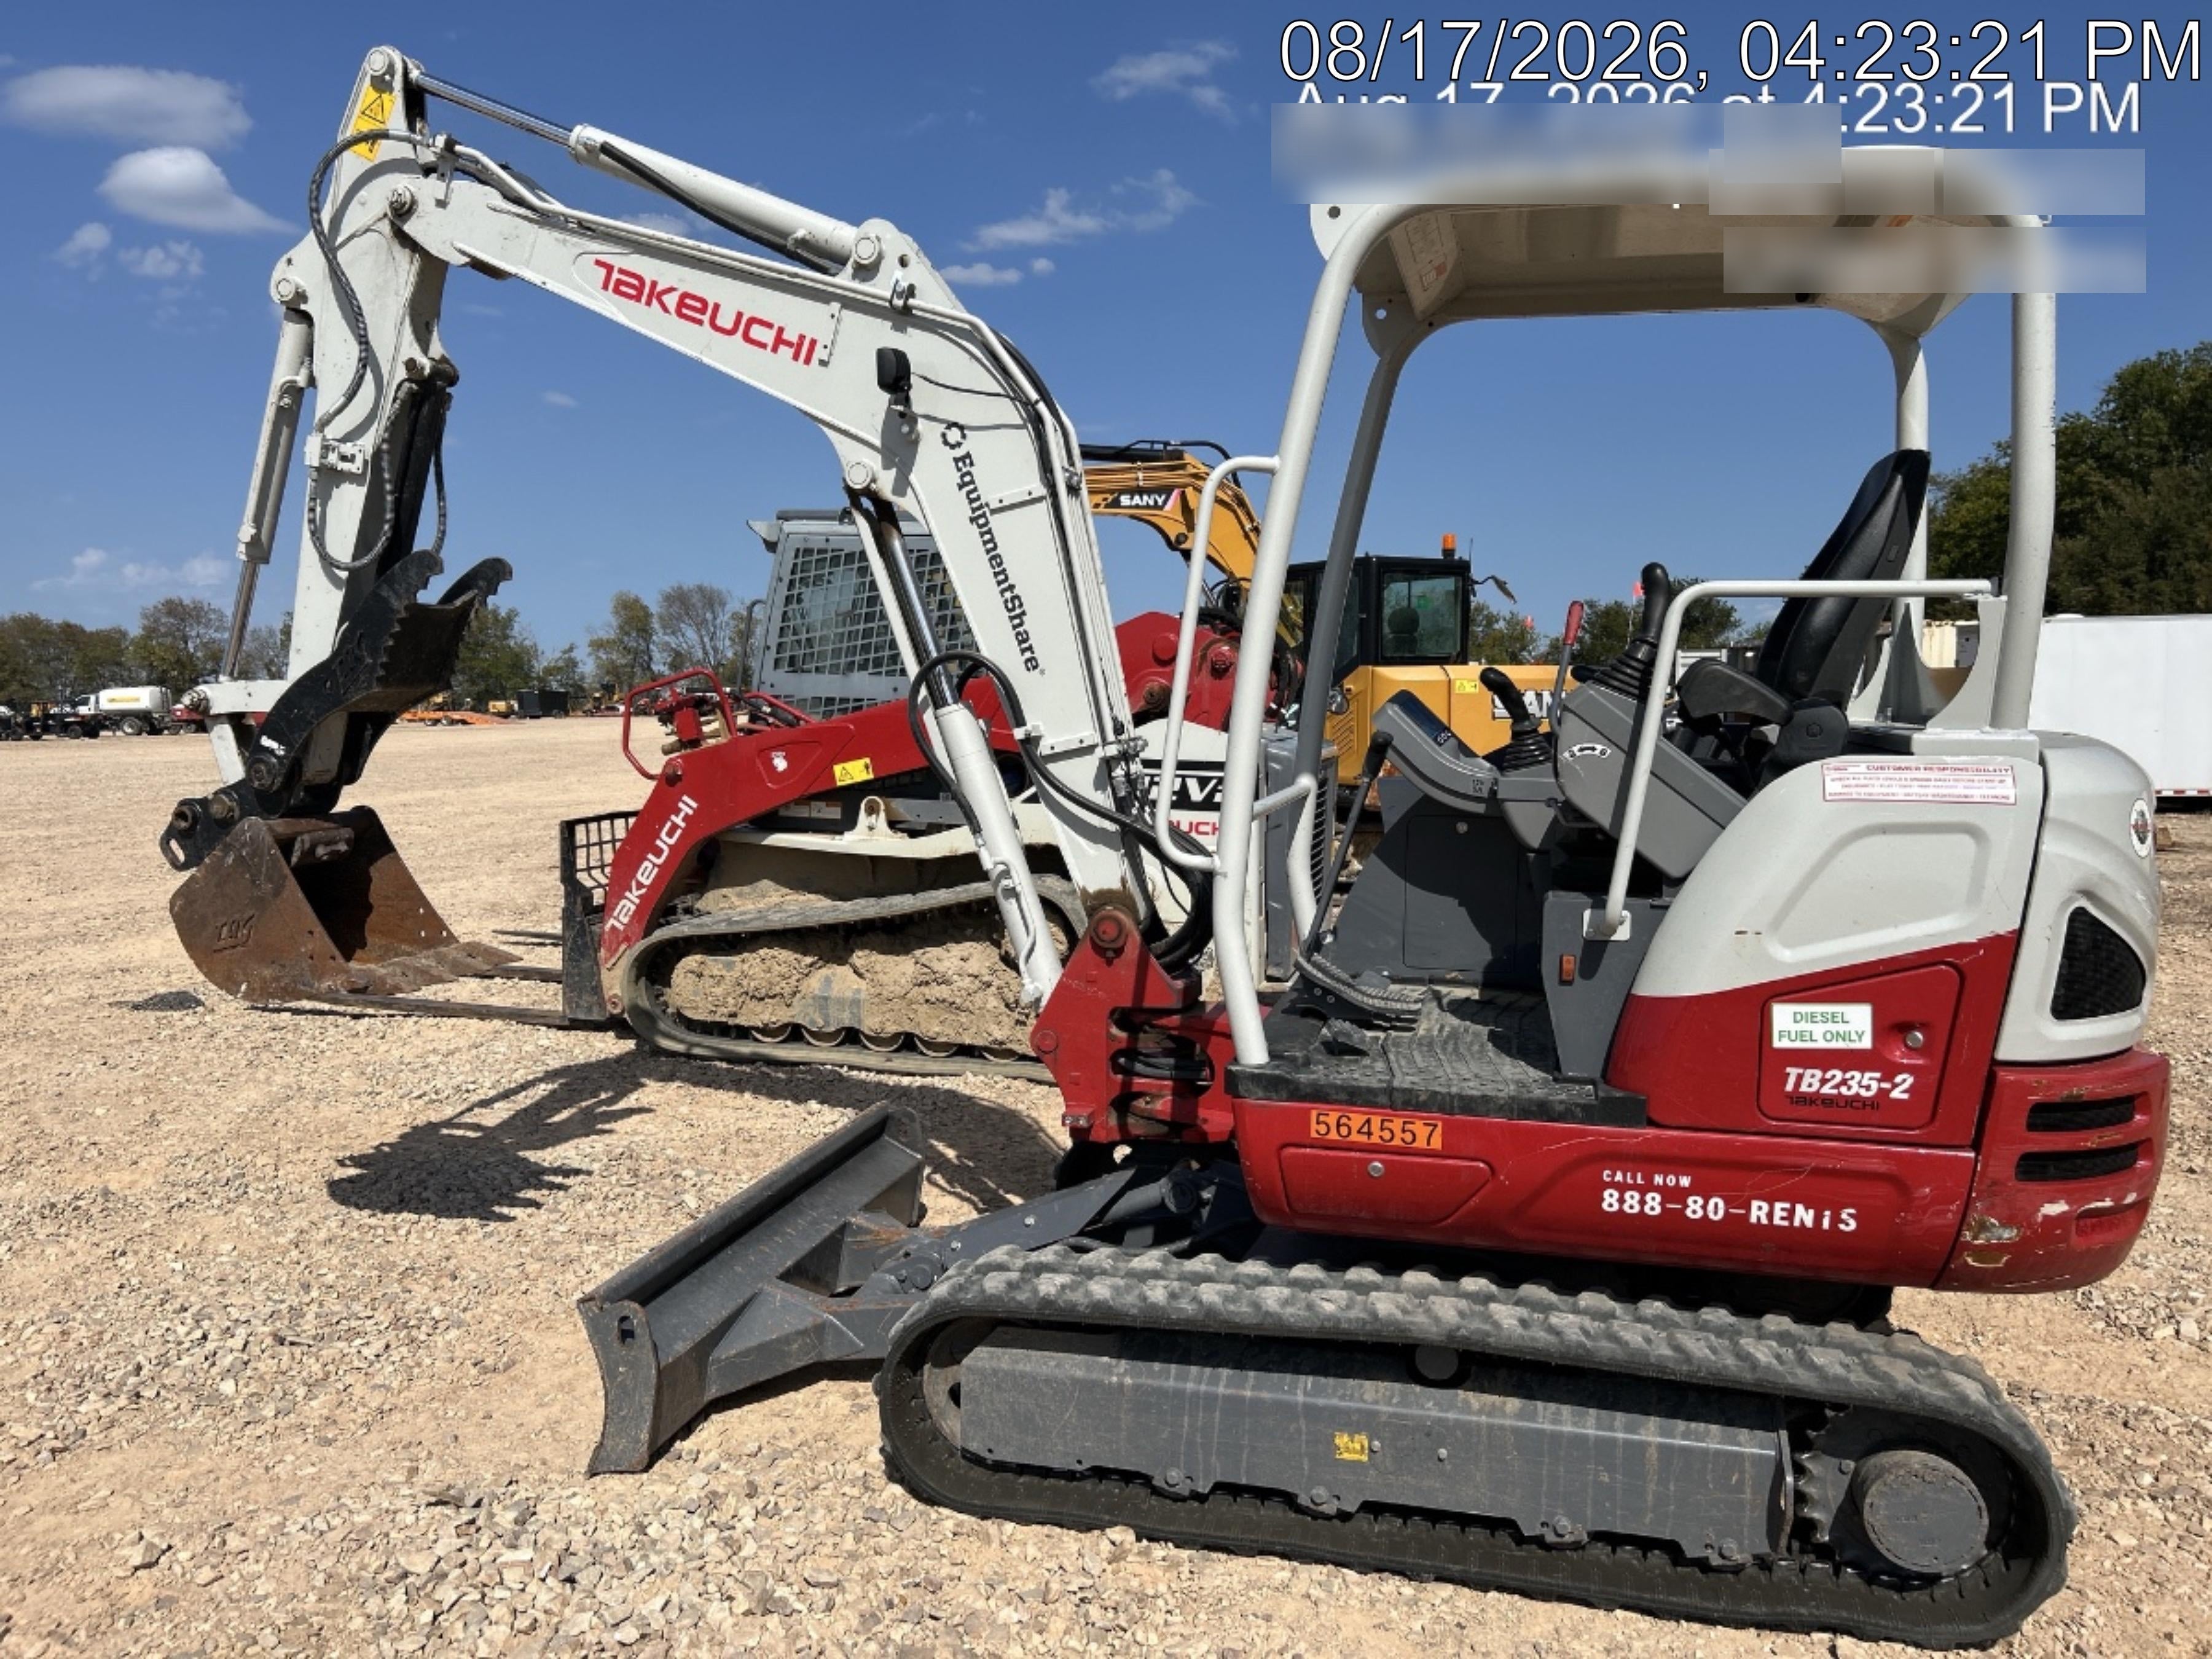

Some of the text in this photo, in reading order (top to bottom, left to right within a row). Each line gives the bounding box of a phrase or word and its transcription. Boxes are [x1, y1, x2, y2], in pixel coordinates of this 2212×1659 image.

[1120, 493, 1166, 506] SANY
[1793, 1011, 1849, 1023] DIESEL
[1778, 1030, 1865, 1043] FUEL ONLY
[1784, 1067, 1915, 1100] TB235-2
[1315, 1112, 1439, 1147] 564557
[1602, 1170, 1692, 1188] CALL NOW
